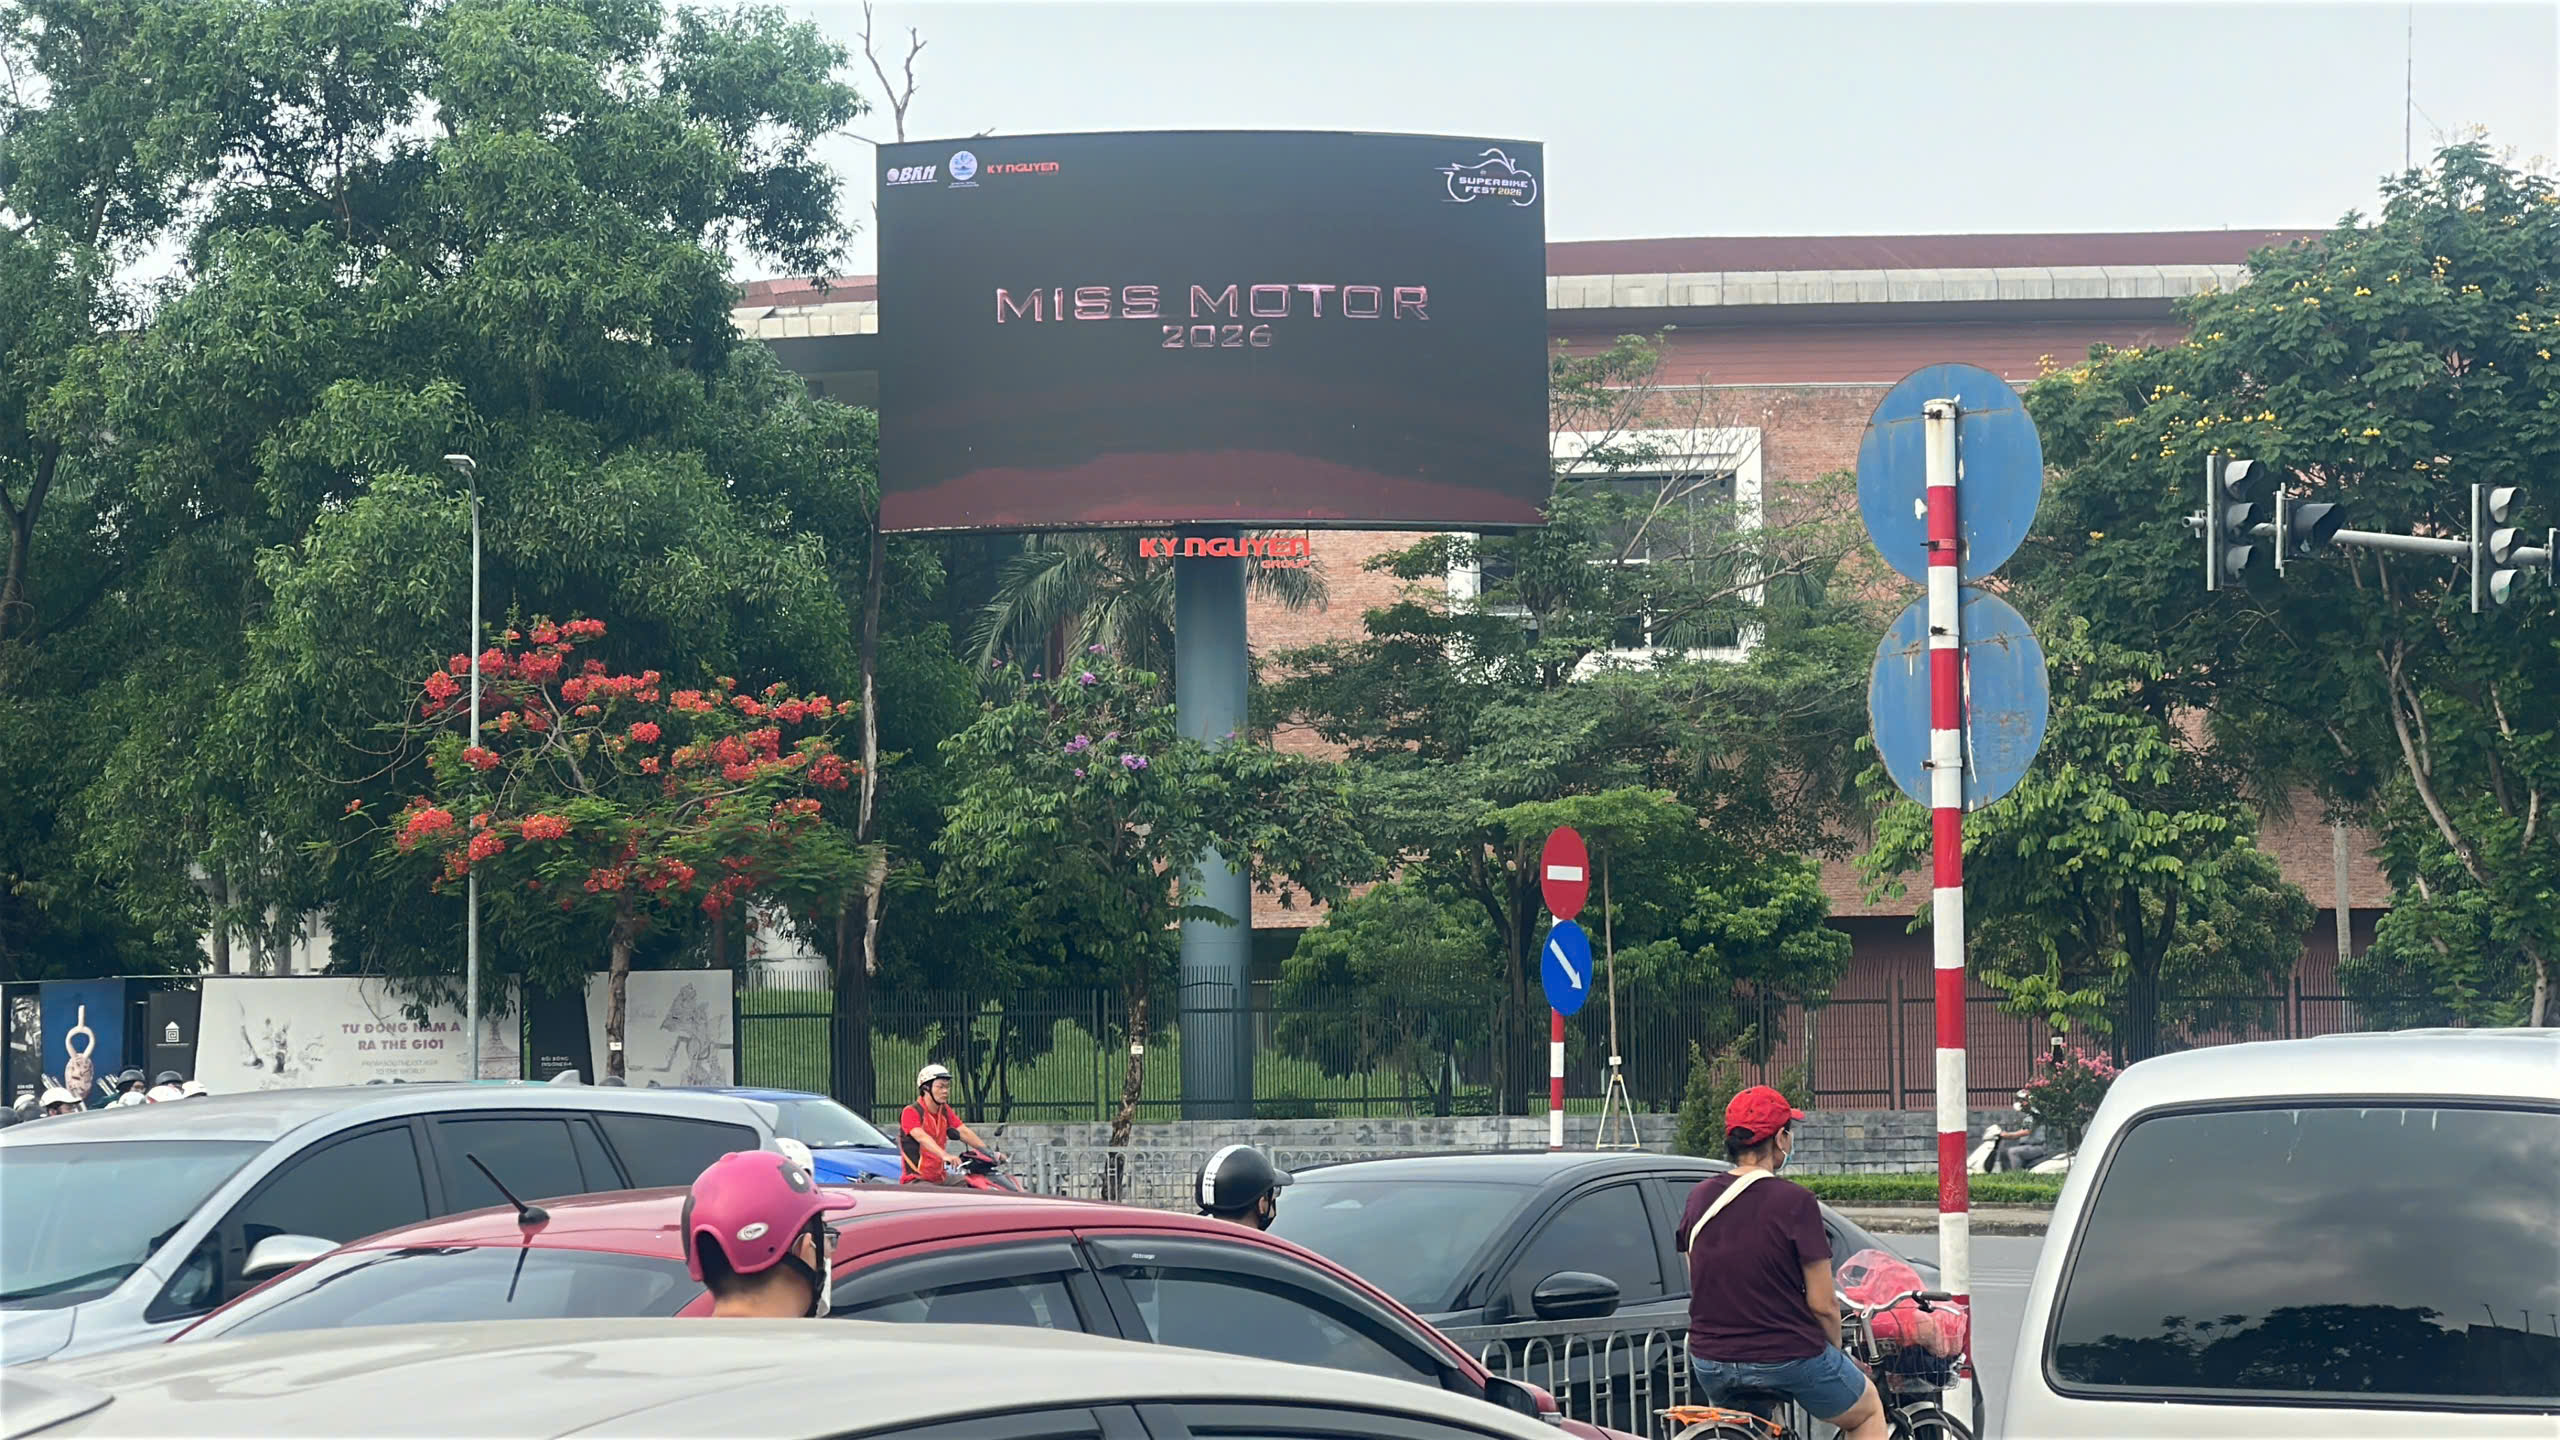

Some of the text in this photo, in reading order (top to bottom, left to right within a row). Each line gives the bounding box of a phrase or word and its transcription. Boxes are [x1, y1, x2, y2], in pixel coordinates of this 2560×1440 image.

[1459, 177, 1528, 188] SUPERBIKE
[1465, 186, 1522, 197] FEST 2026
[996, 284, 1430, 323] MISS MOTOR
[1162, 324, 1272, 349] 2026
[1139, 537, 1178, 558] KY
[1260, 559, 1310, 569] GROUP
[413, 1021, 447, 1033] NAM
[358, 1040, 376, 1050] RA
